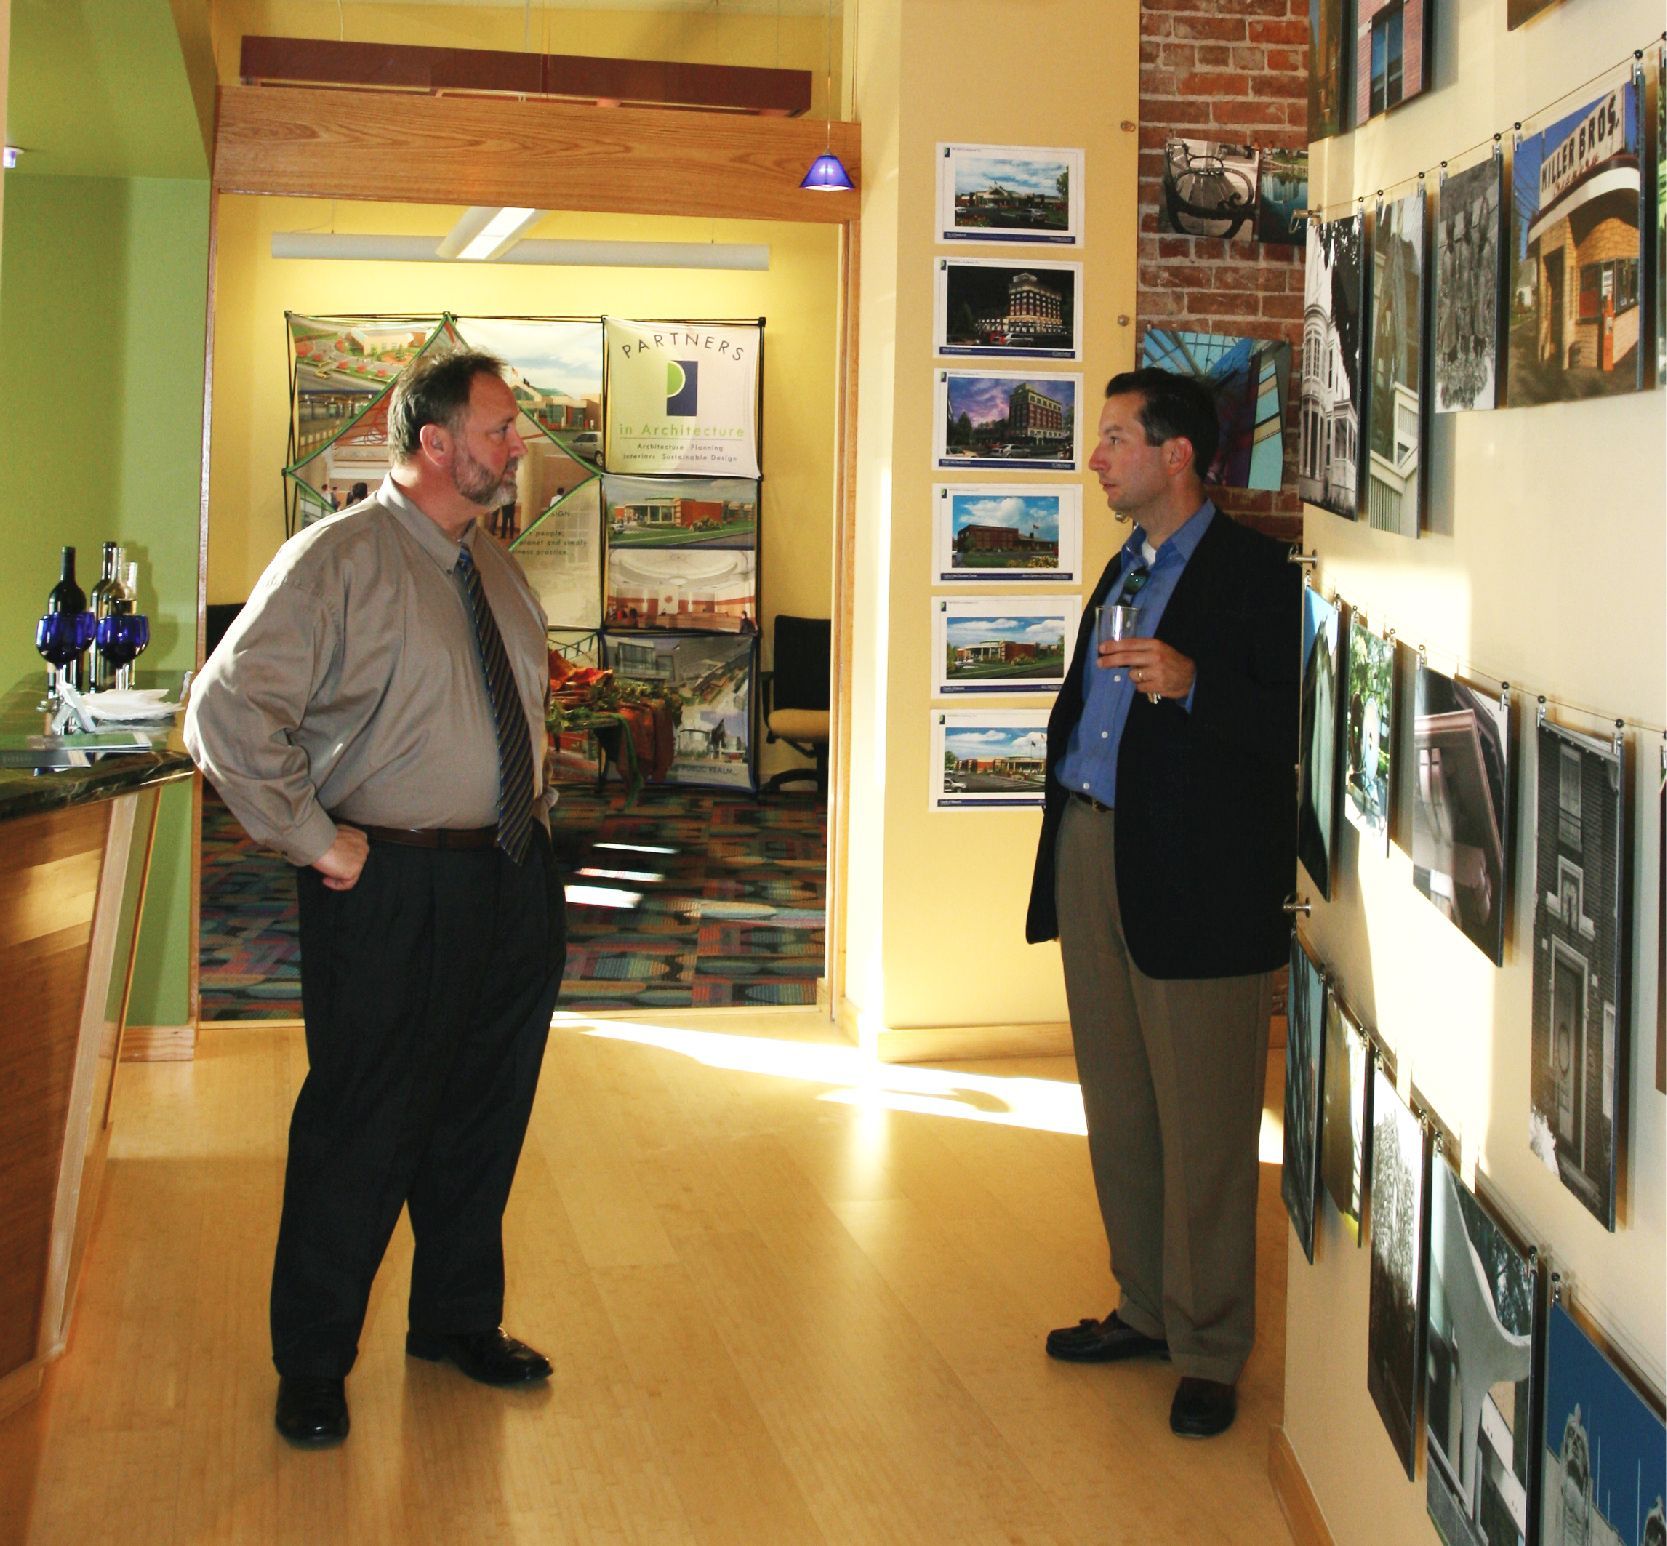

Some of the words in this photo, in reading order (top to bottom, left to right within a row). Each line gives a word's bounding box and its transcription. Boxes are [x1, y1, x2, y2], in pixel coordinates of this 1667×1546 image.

[1541, 137, 1575, 193] MILLER
[622, 332, 744, 361] PARTNERS
[619, 423, 633, 435] in
[641, 424, 744, 437] Architecture
[637, 443, 684, 451] Architecture
[690, 444, 724, 452] Planning
[711, 454, 738, 462] Design
